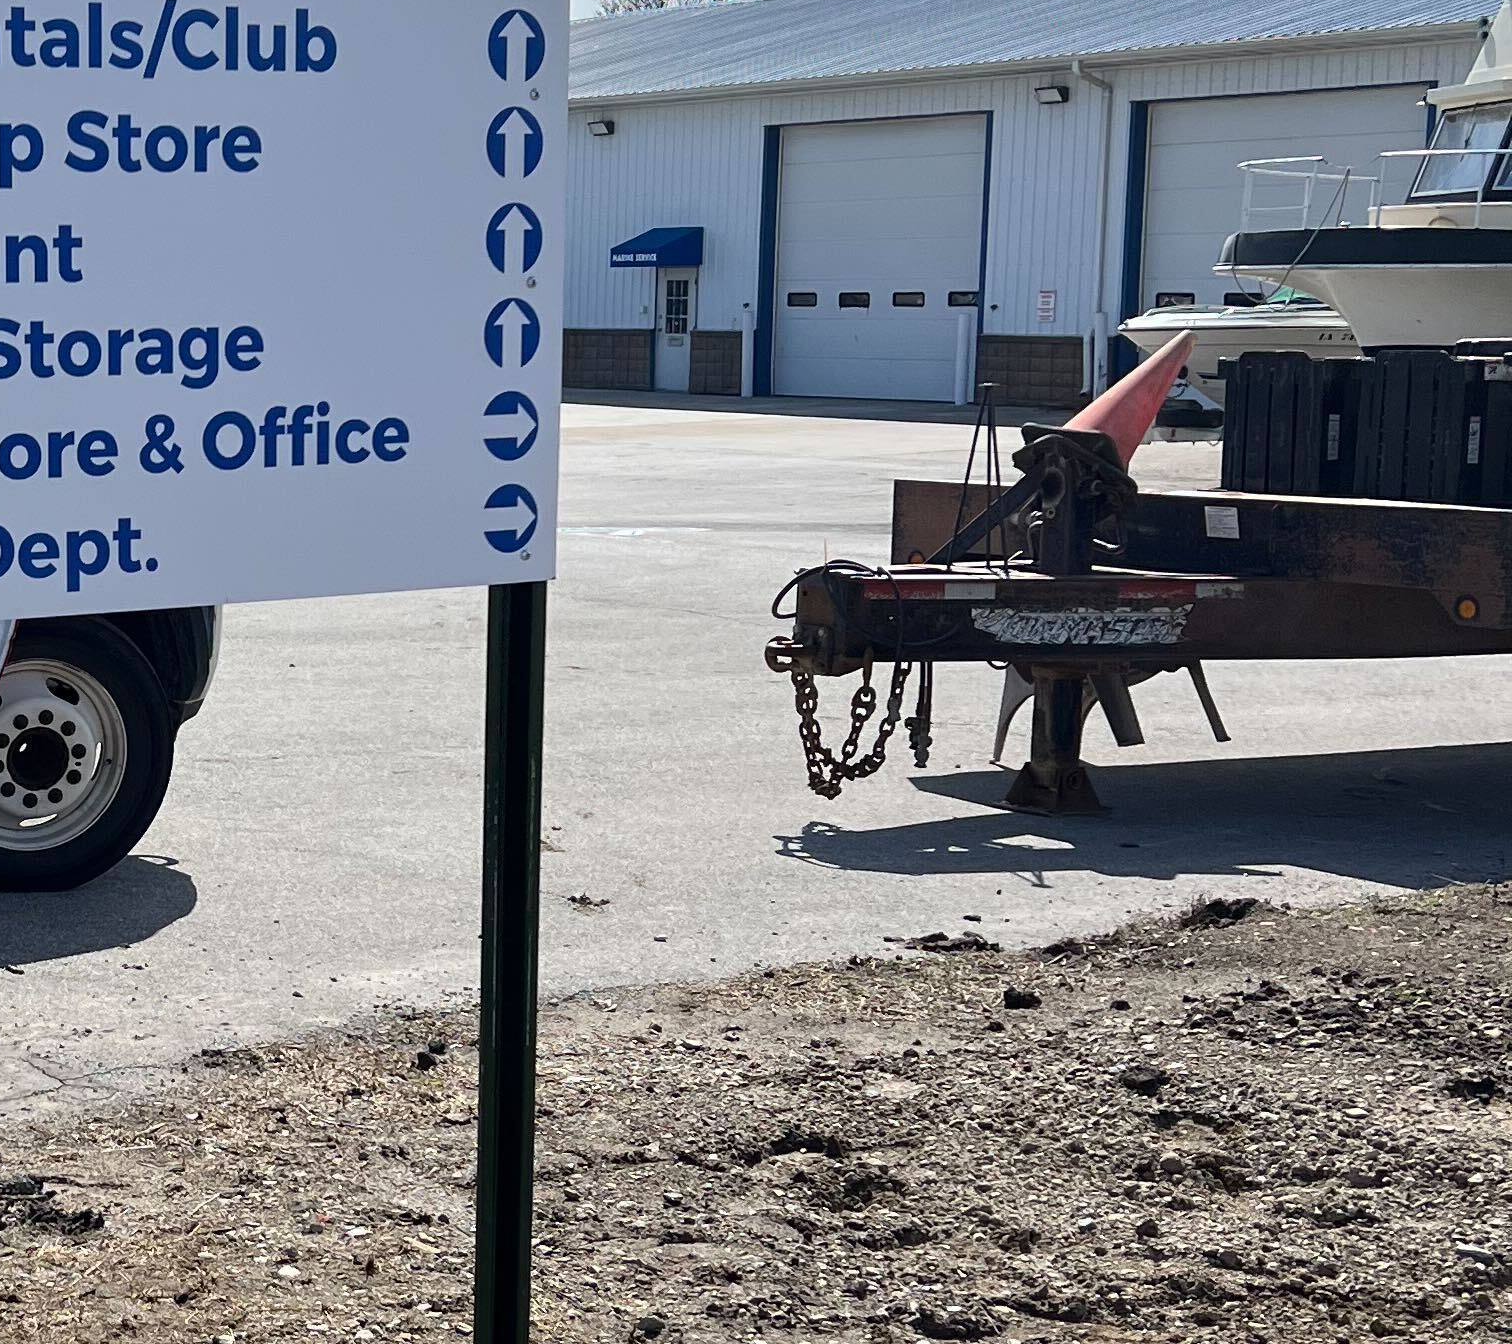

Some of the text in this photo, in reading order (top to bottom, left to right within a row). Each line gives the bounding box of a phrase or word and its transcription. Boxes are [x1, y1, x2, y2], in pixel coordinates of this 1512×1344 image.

[63, 109, 262, 174] Store
[138, 413, 187, 475] &
[201, 399, 411, 472] Office
